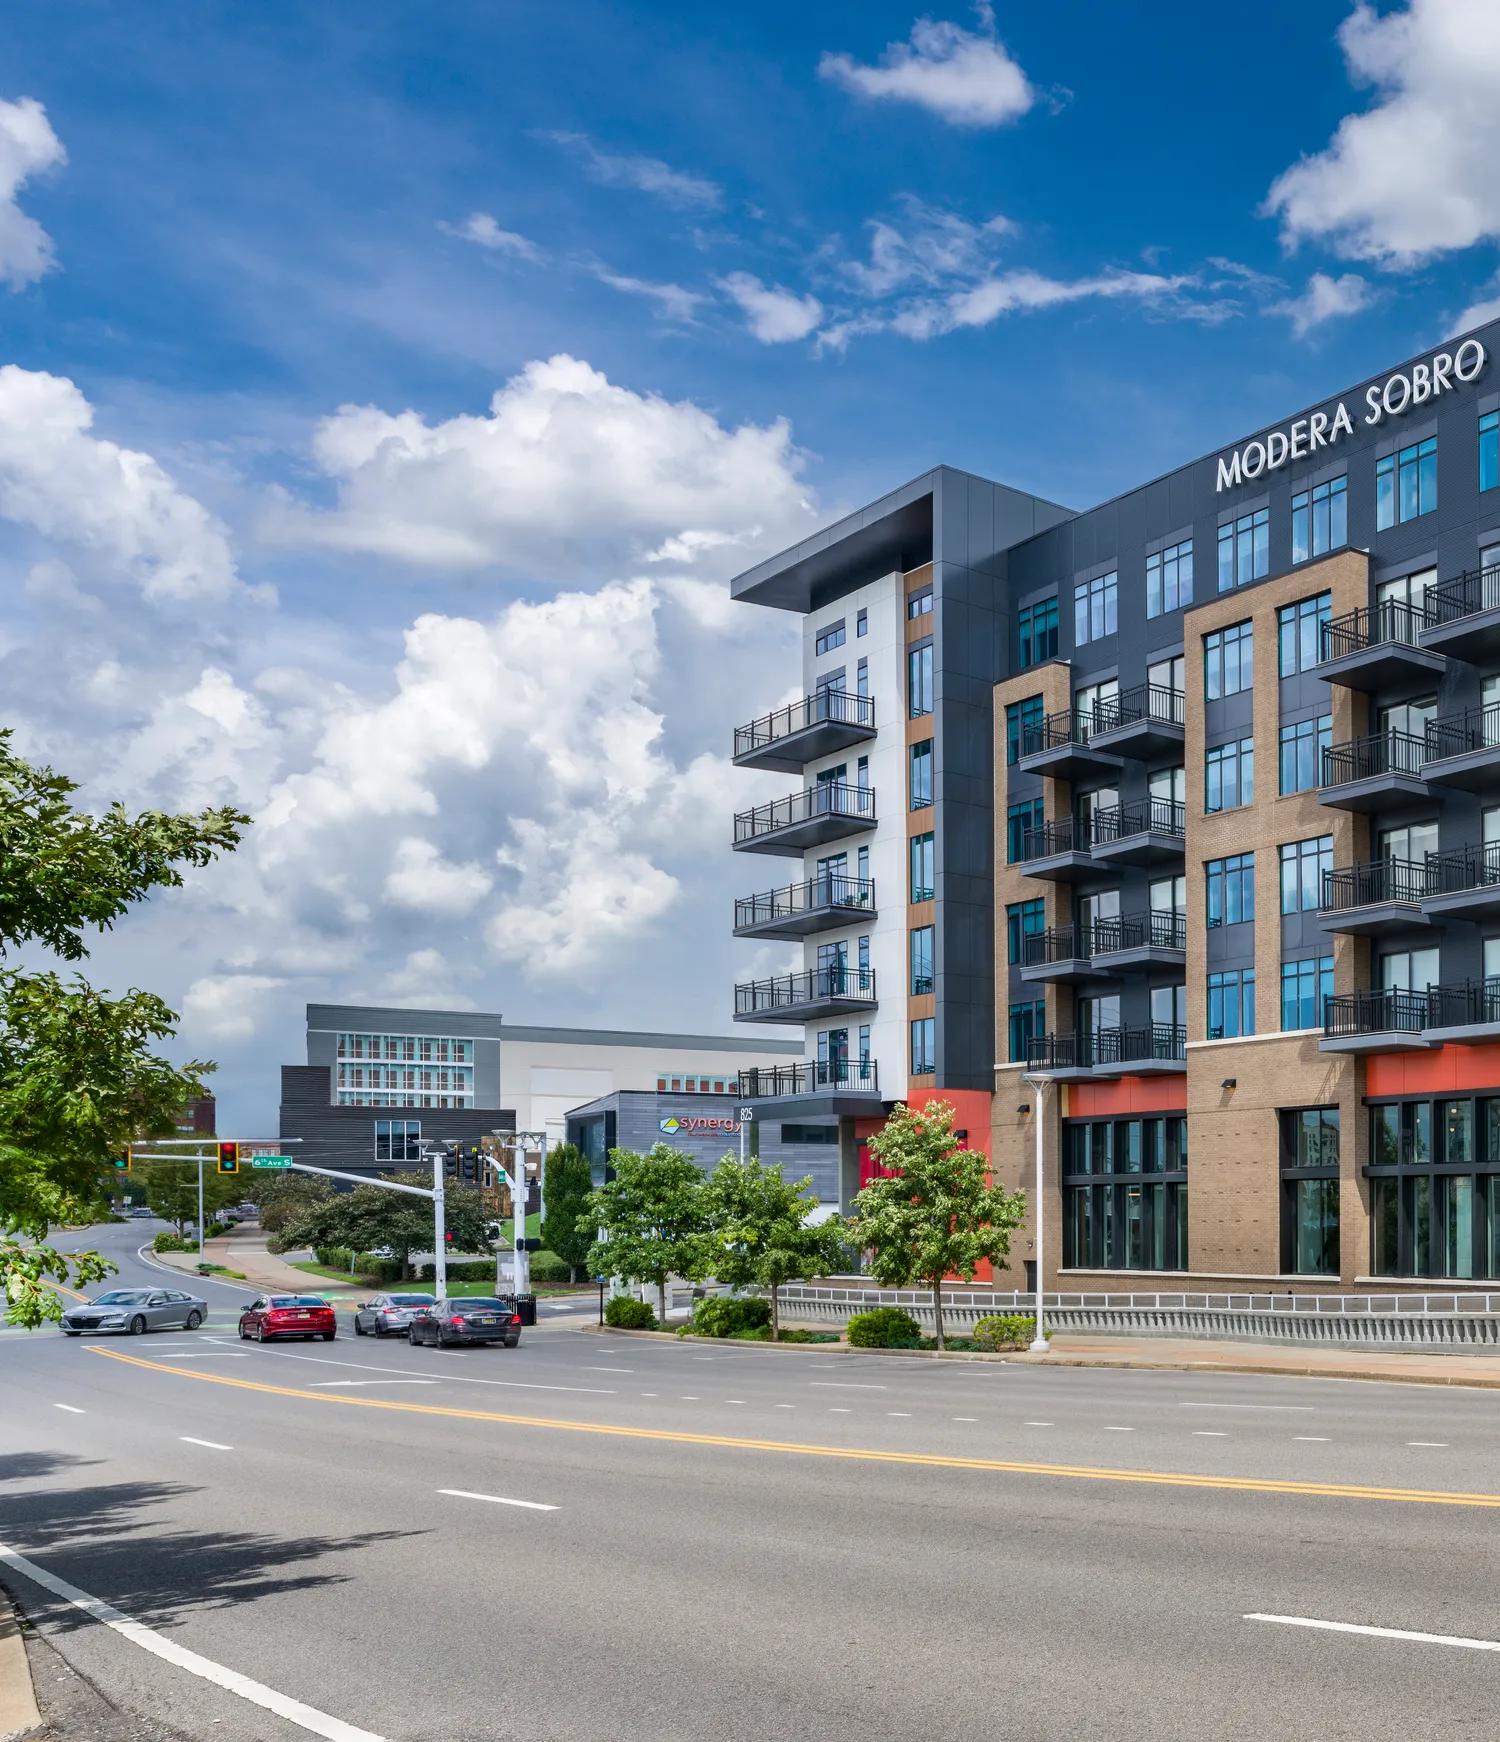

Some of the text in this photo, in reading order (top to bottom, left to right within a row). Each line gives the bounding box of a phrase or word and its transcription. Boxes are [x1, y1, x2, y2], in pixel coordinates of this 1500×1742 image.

[1216, 339, 1484, 492] MODERA SOBRO
[740, 1107, 753, 1121] 825
[680, 1117, 741, 1132] synergy
[254, 1158, 267, 1166] 6th
